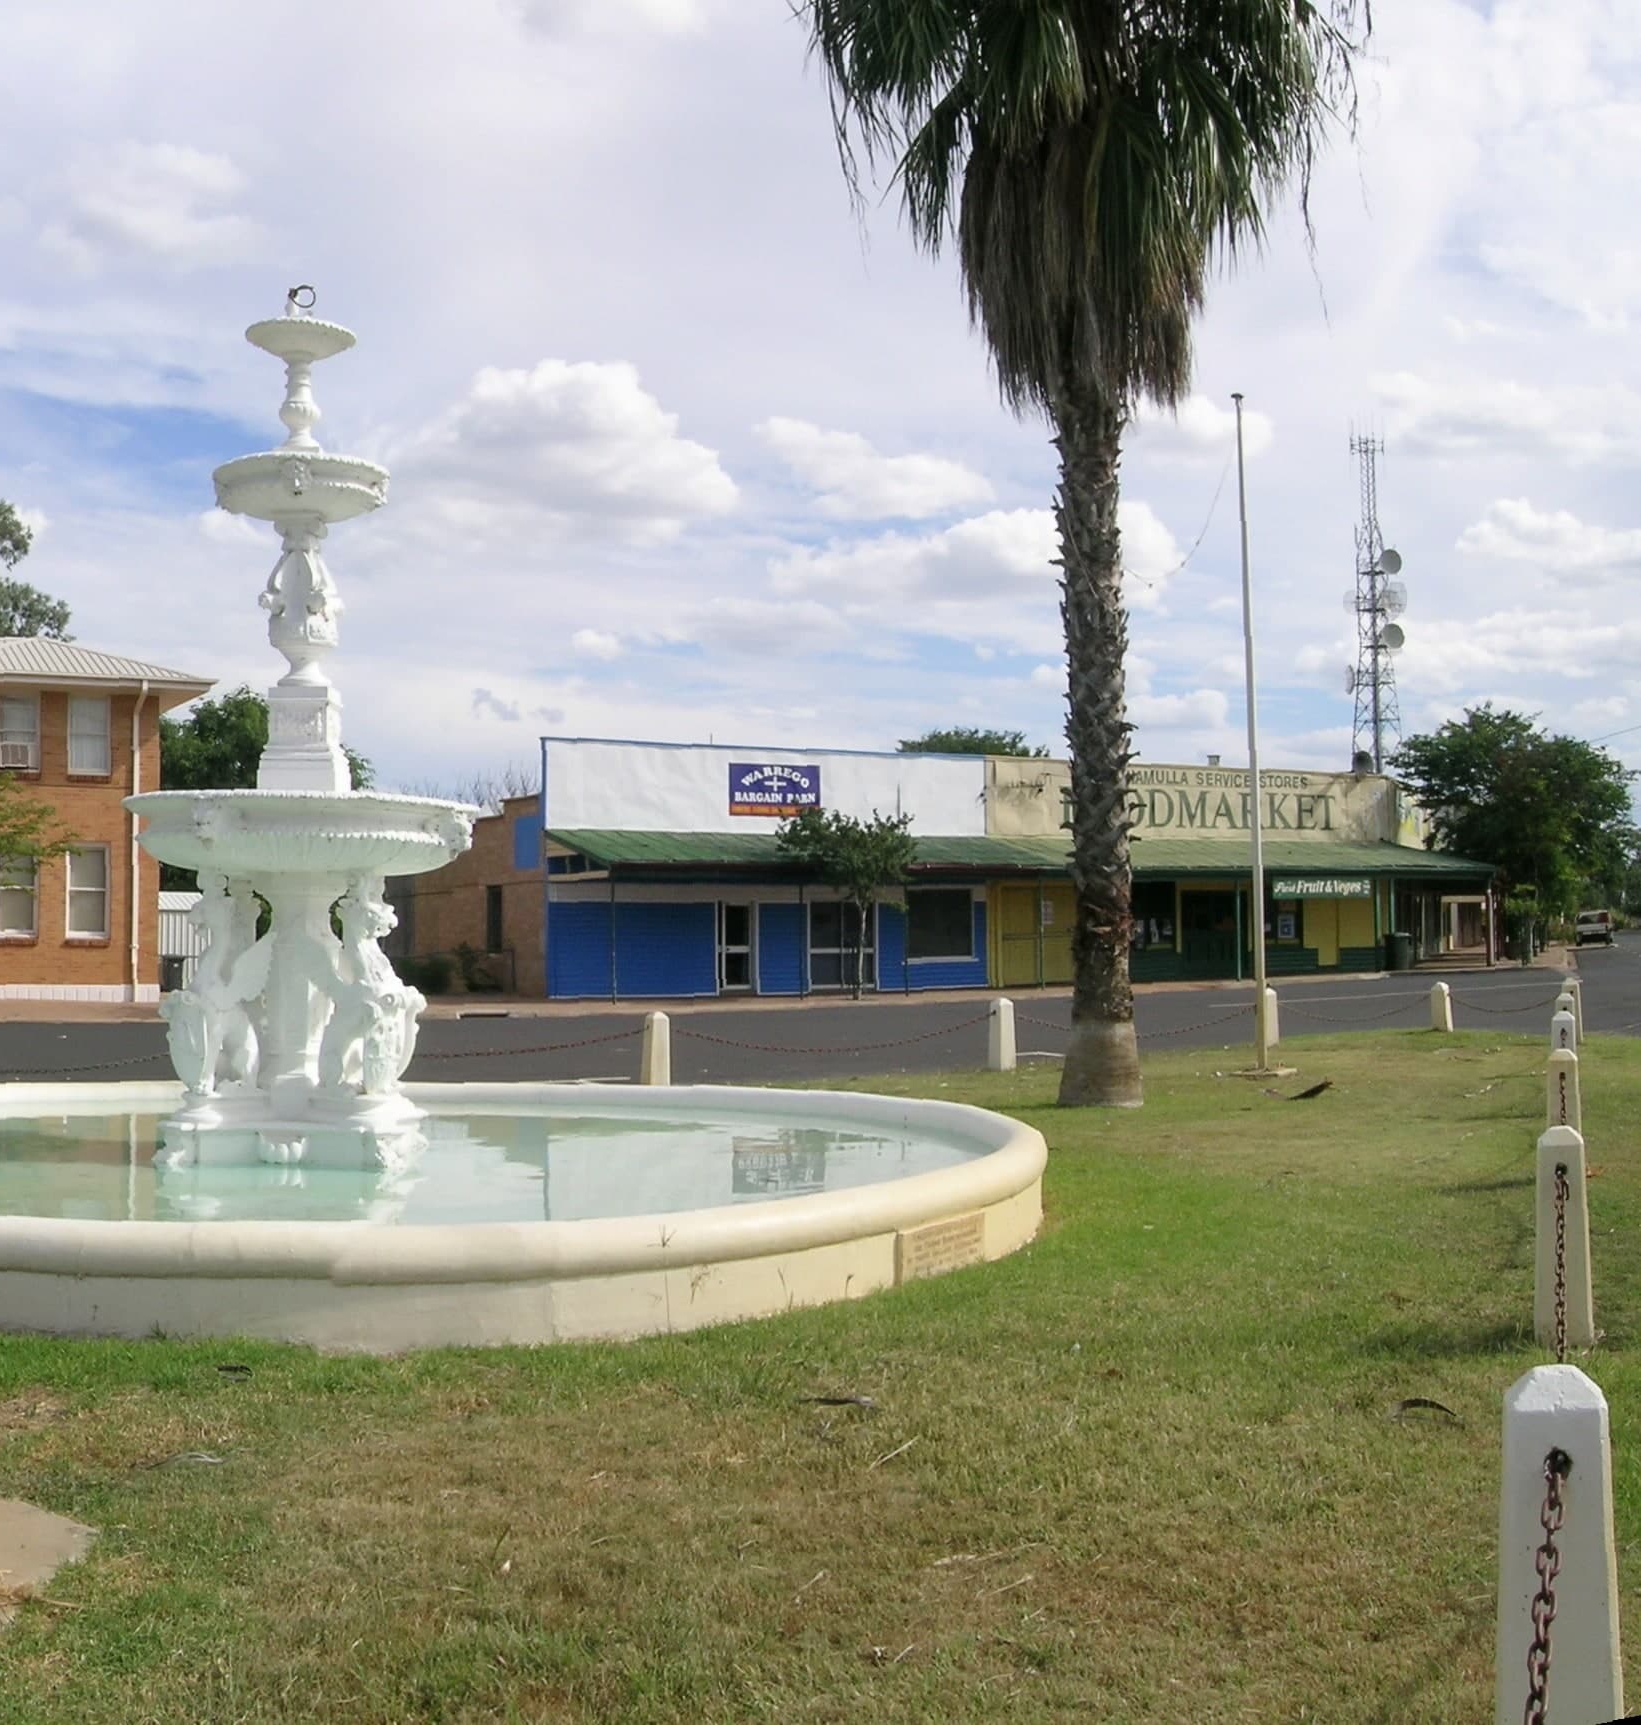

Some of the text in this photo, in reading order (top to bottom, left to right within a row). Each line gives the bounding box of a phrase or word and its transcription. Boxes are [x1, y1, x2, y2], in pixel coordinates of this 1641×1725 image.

[741, 766, 810, 788] WARREGO
[1196, 772, 1251, 788] SERVICE
[1258, 774, 1308, 789] STORES
[734, 791, 783, 803] BARGAIN
[1296, 880, 1325, 893] Fruit
